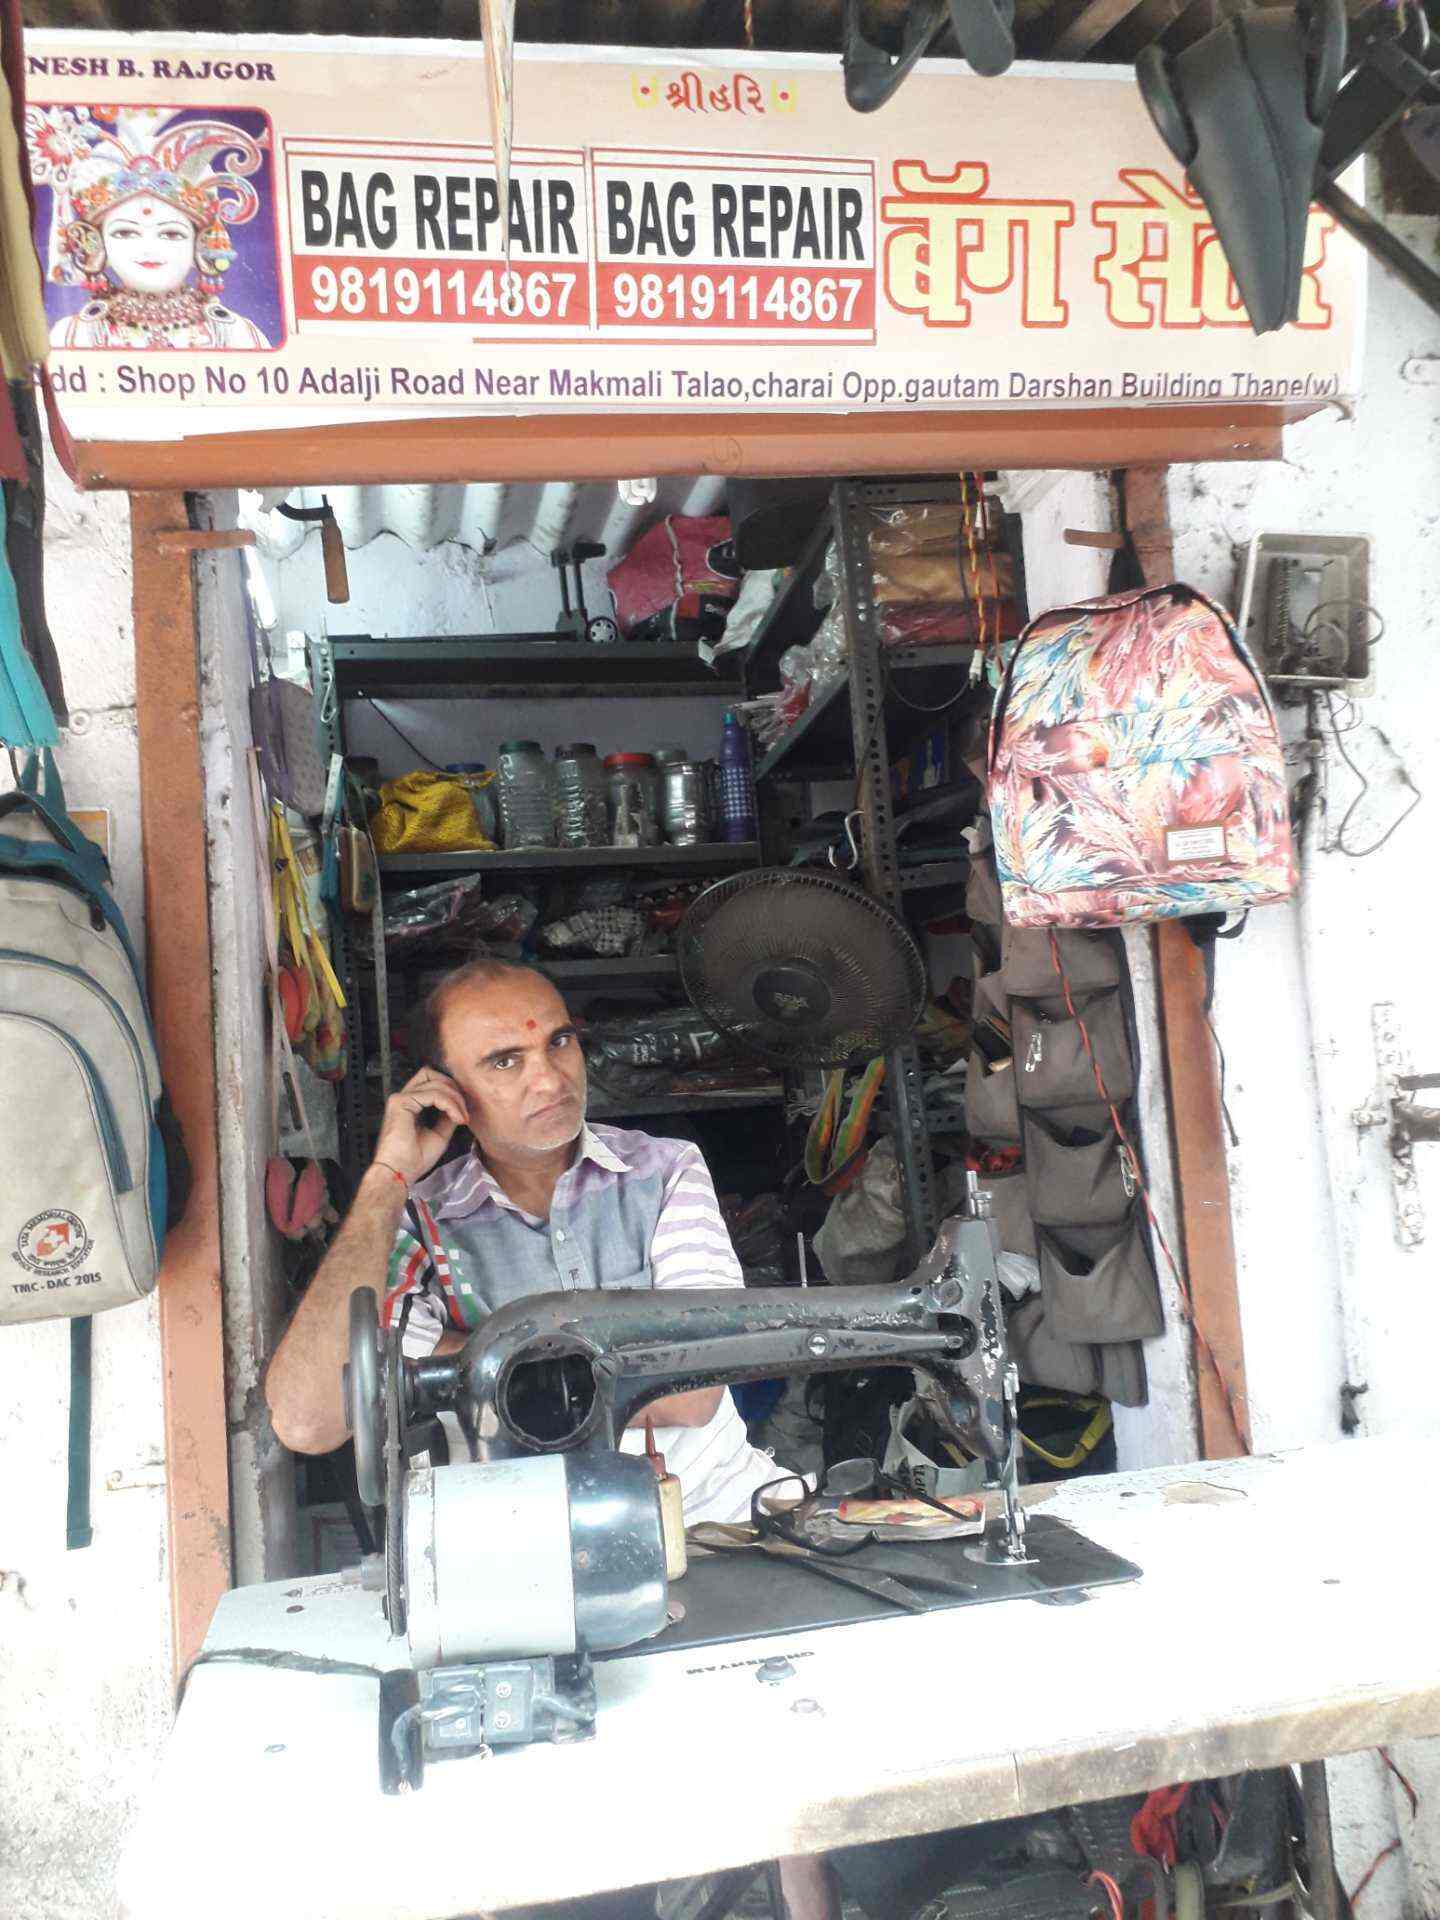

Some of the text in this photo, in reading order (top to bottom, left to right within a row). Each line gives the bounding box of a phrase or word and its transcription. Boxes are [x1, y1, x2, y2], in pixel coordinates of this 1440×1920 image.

[25, 56, 276, 81] NESH B. RAJGOR
[301, 170, 579, 254] BAG REPAIR
[606, 180, 865, 261] BAG REPAIR
[311, 266, 577, 317] 9819114867
[613, 272, 863, 322] 9819114867
[117, 365, 196, 400] Shop
[205, 366, 246, 394] No
[257, 366, 289, 394] 10
[299, 367, 380, 401] Adalji
[391, 367, 464, 395] Road
[475, 368, 540, 395] Near
[549, 368, 662, 397] Makmali
[1009, 372, 1112, 398] Darshan
[1120, 372, 1222, 397] Building
[1231, 371, 1339, 397] Thane(w)
[12, 1282, 39, 1294] TMC
[74, 1272, 102, 1287] 2015
